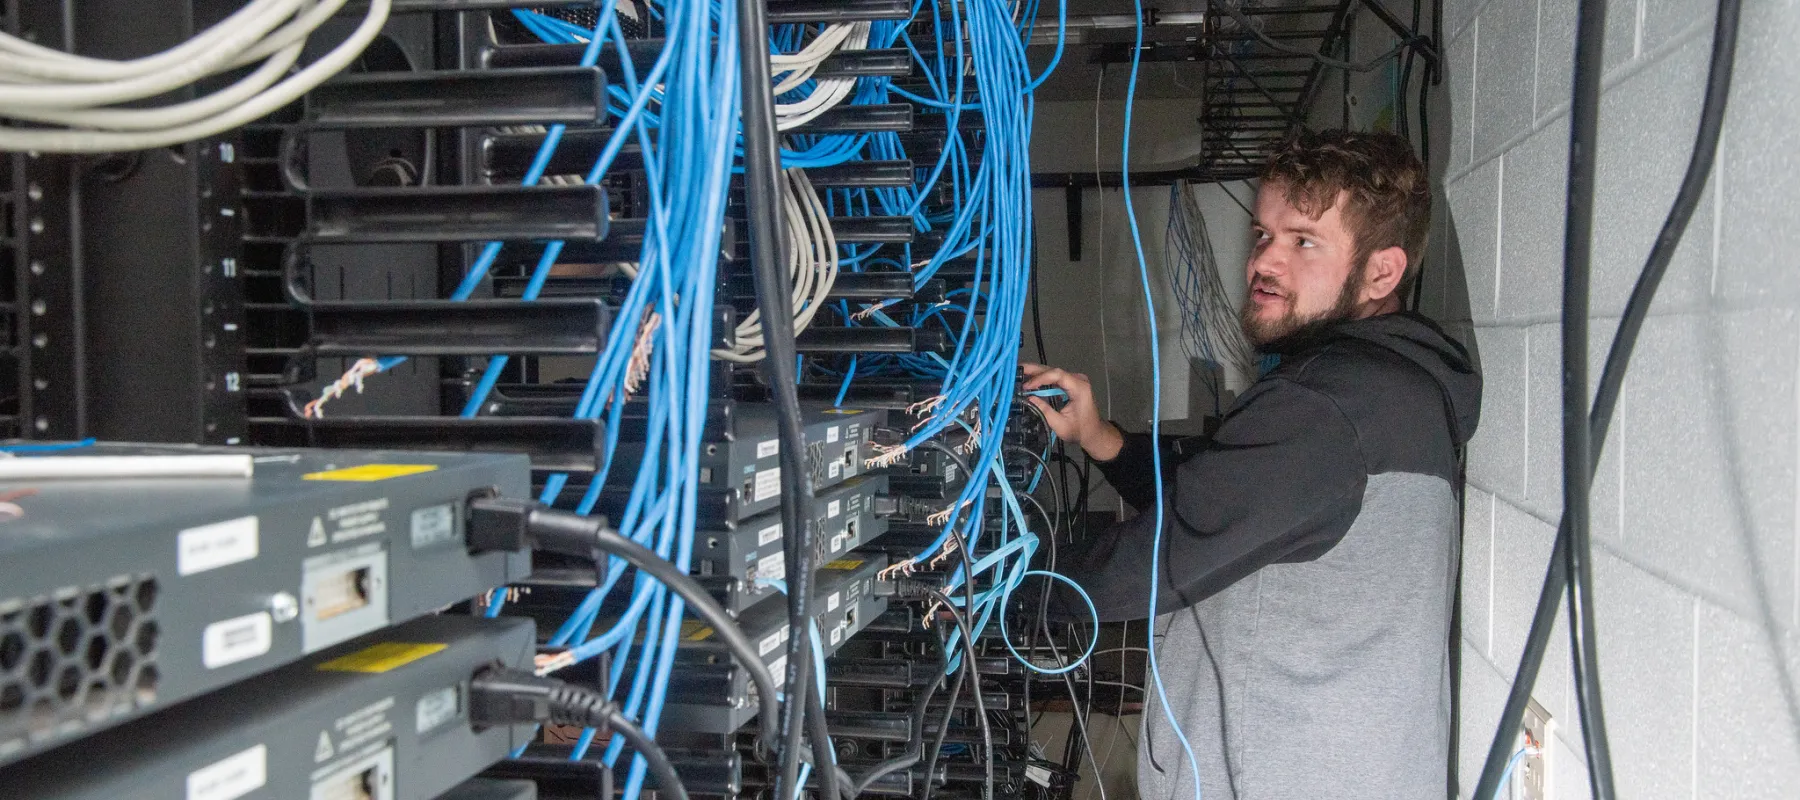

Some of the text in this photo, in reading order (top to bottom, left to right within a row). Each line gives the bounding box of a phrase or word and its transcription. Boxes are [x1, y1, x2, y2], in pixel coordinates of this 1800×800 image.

[219, 142, 235, 163] 10
[222, 257, 236, 278] 11
[225, 371, 240, 392] 12
